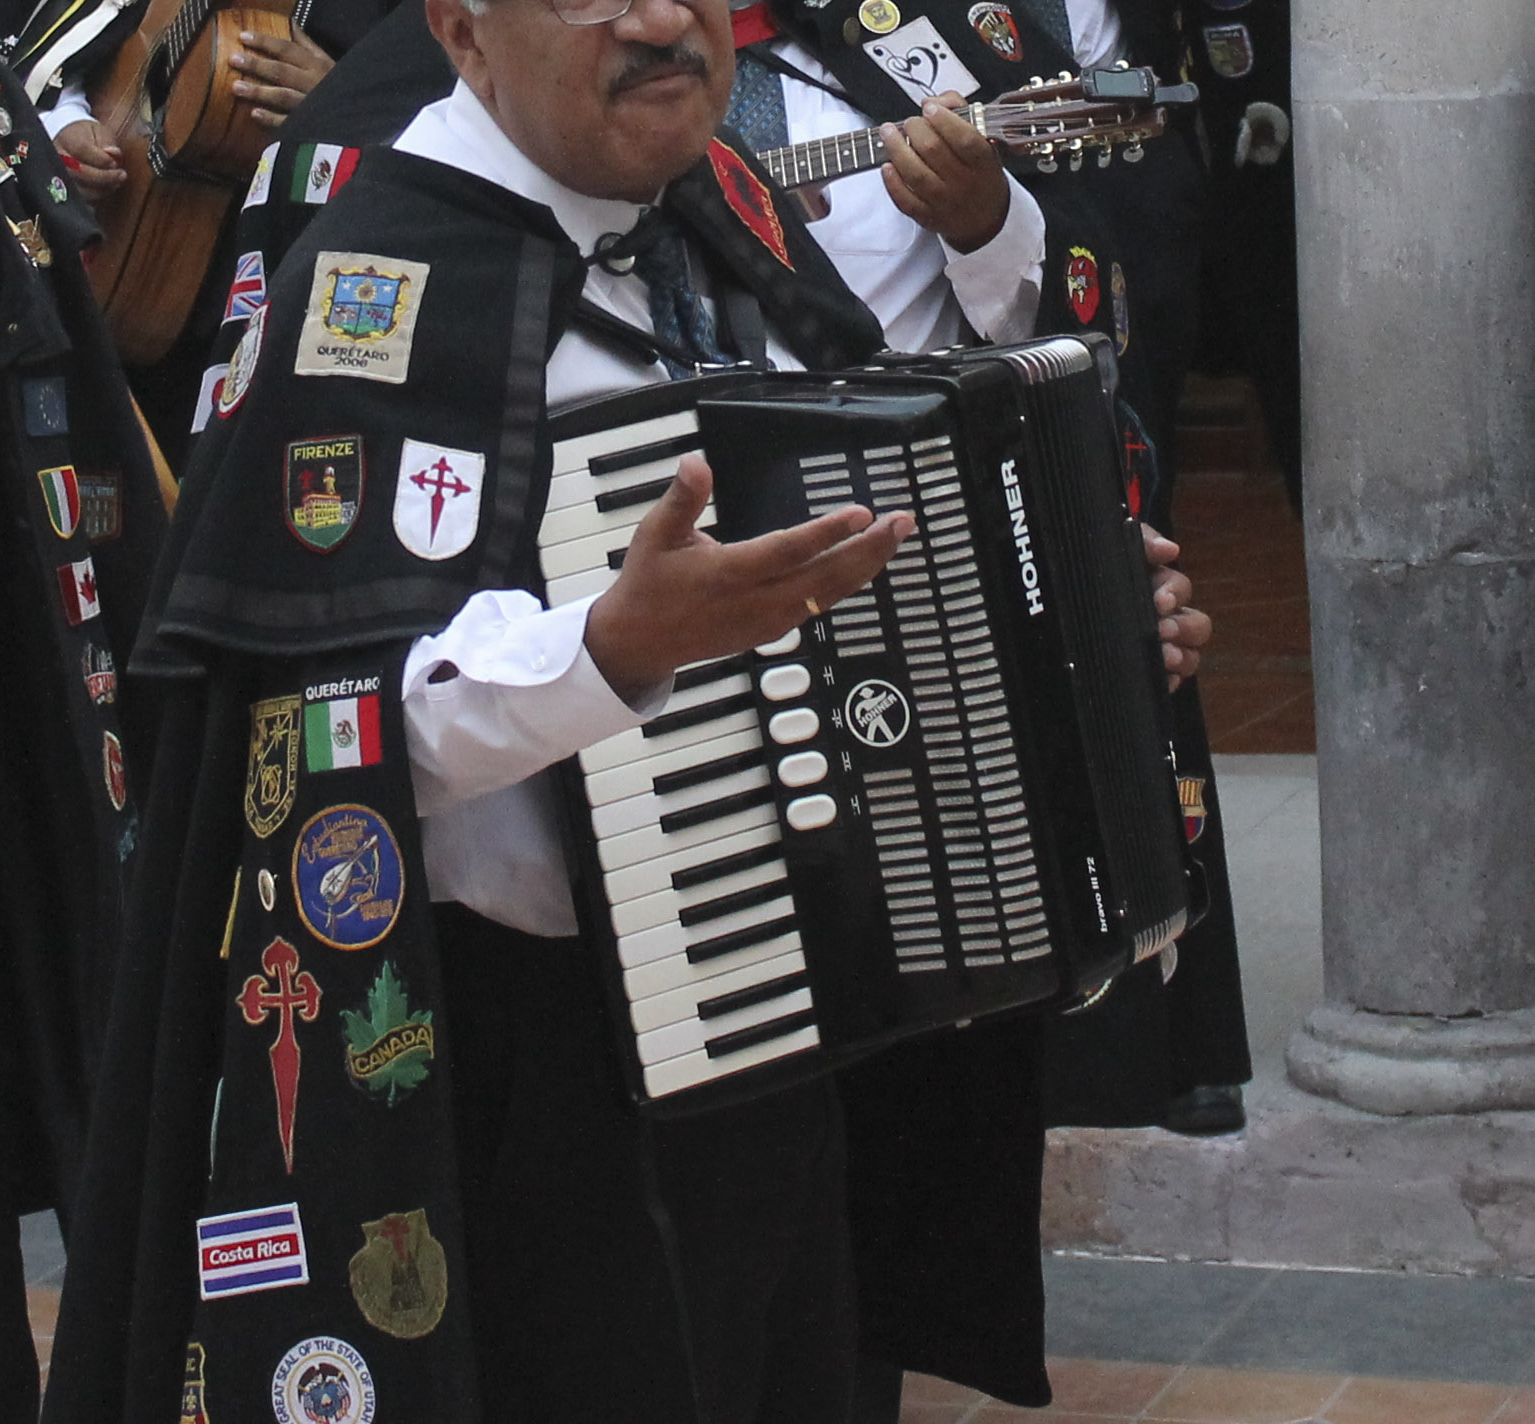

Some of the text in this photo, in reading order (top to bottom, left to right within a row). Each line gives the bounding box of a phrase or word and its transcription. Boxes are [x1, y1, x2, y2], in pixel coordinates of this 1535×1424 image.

[294, 442, 355, 461] FIRENZE
[1001, 459, 1044, 615] HOHNER
[305, 676, 380, 700] QUERÉTARO
[858, 693, 897, 727] HOHNER
[1086, 857, 1096, 874] 72
[1095, 892, 1108, 932] bravo
[354, 1026, 429, 1073] CANADA
[209, 1239, 291, 1264] Costa Rica
[274, 1340, 376, 1424] GREAT SEAL OF THE STATE OF UTAH
